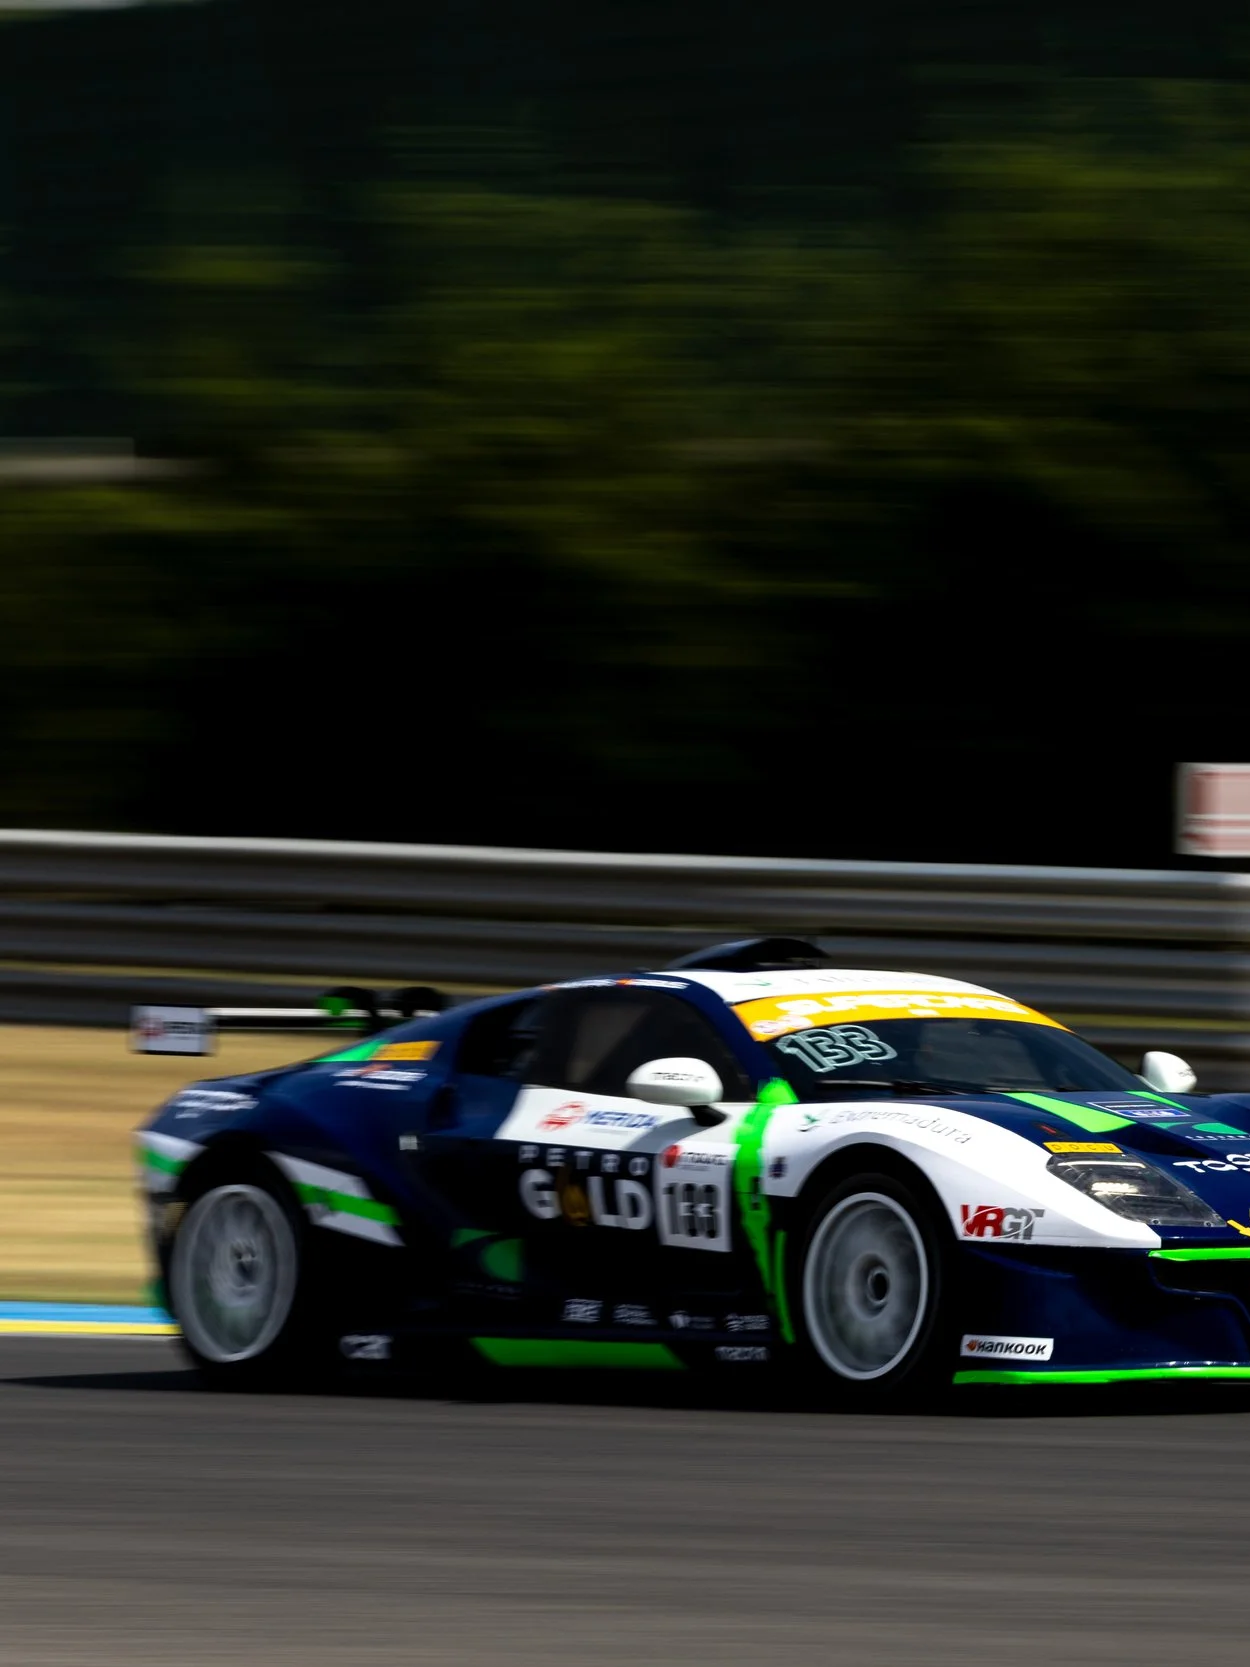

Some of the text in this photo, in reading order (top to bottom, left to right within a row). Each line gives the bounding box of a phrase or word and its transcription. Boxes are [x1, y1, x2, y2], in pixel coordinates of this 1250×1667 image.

[774, 1024, 899, 1073] 133
[518, 1145, 650, 1177] PETRO
[961, 1204, 1045, 1241] VRGT
